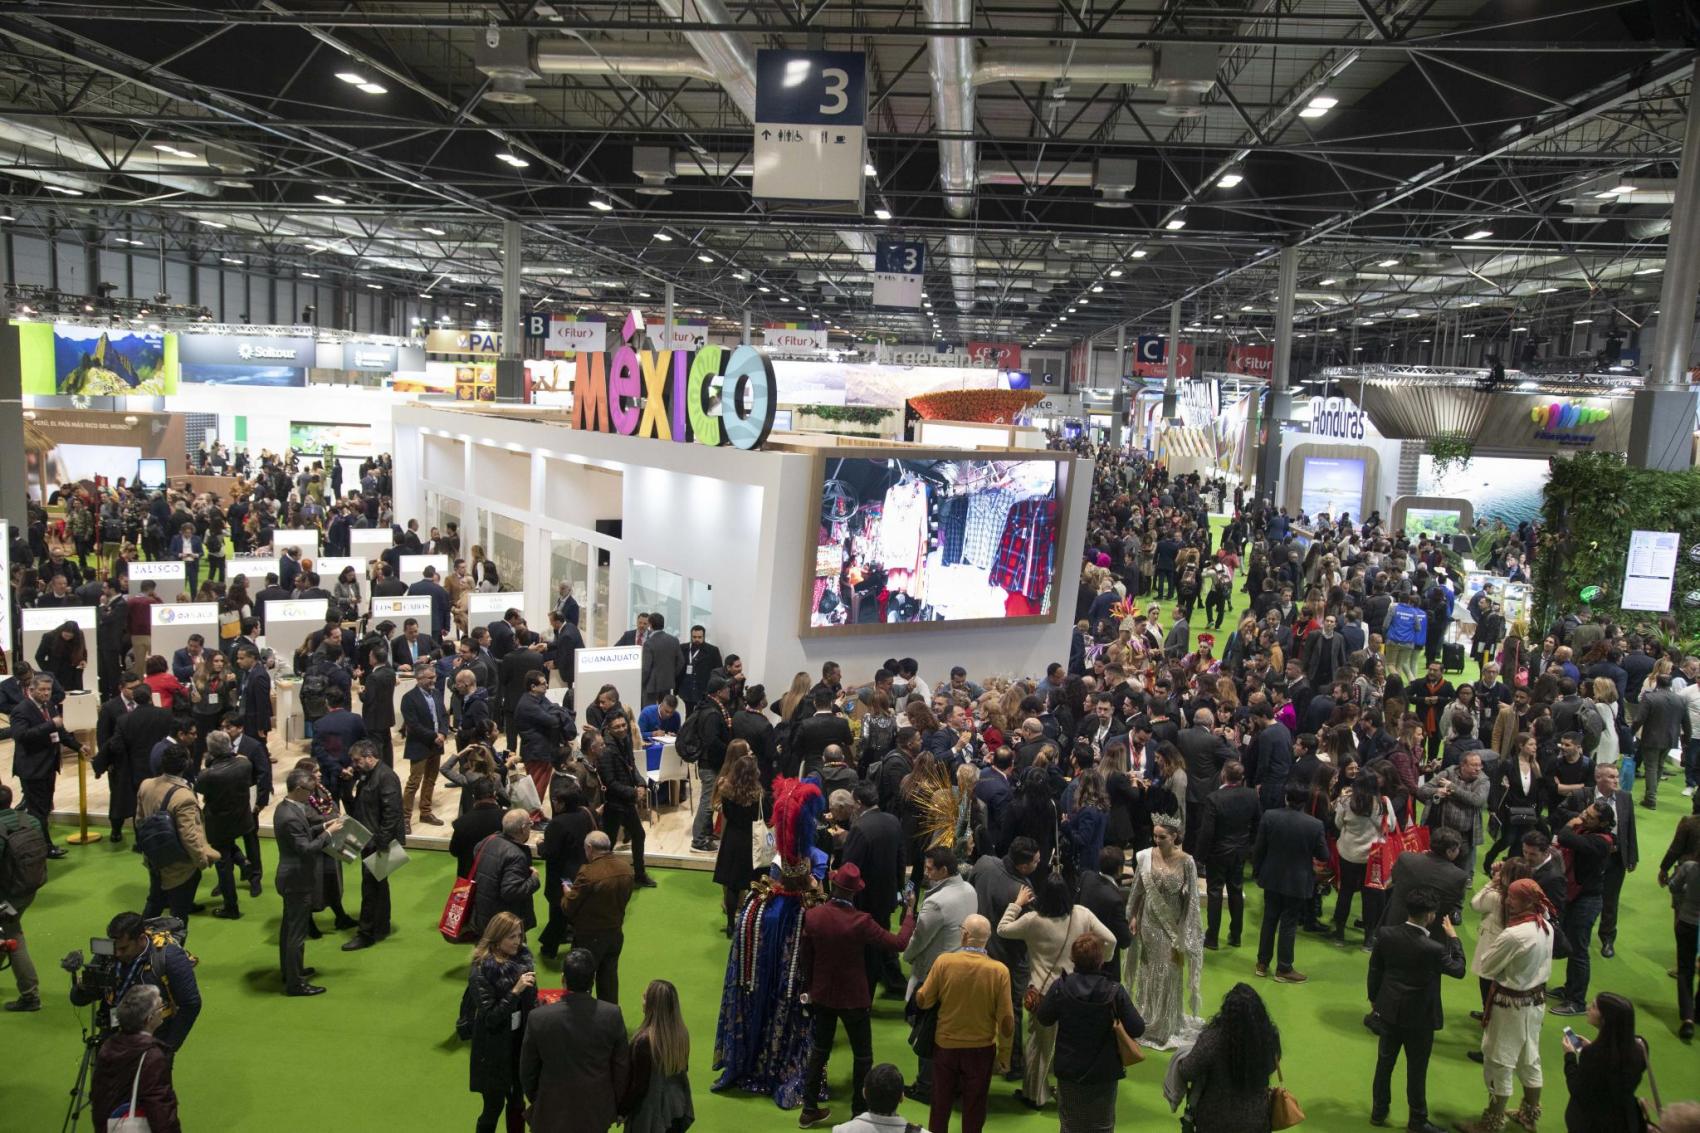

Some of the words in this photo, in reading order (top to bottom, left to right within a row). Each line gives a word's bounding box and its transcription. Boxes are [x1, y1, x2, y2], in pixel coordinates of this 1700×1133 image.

[819, 68, 849, 115] 3
[903, 248, 917, 270] 3
[531, 316, 544, 335] B
[564, 327, 588, 338] Fitur
[784, 336, 808, 346] Fitur
[1143, 340, 1159, 360] C
[1044, 374, 1052, 383] C
[1311, 401, 1365, 440] Honduras
[581, 653, 640, 664] GUANAJUATO
